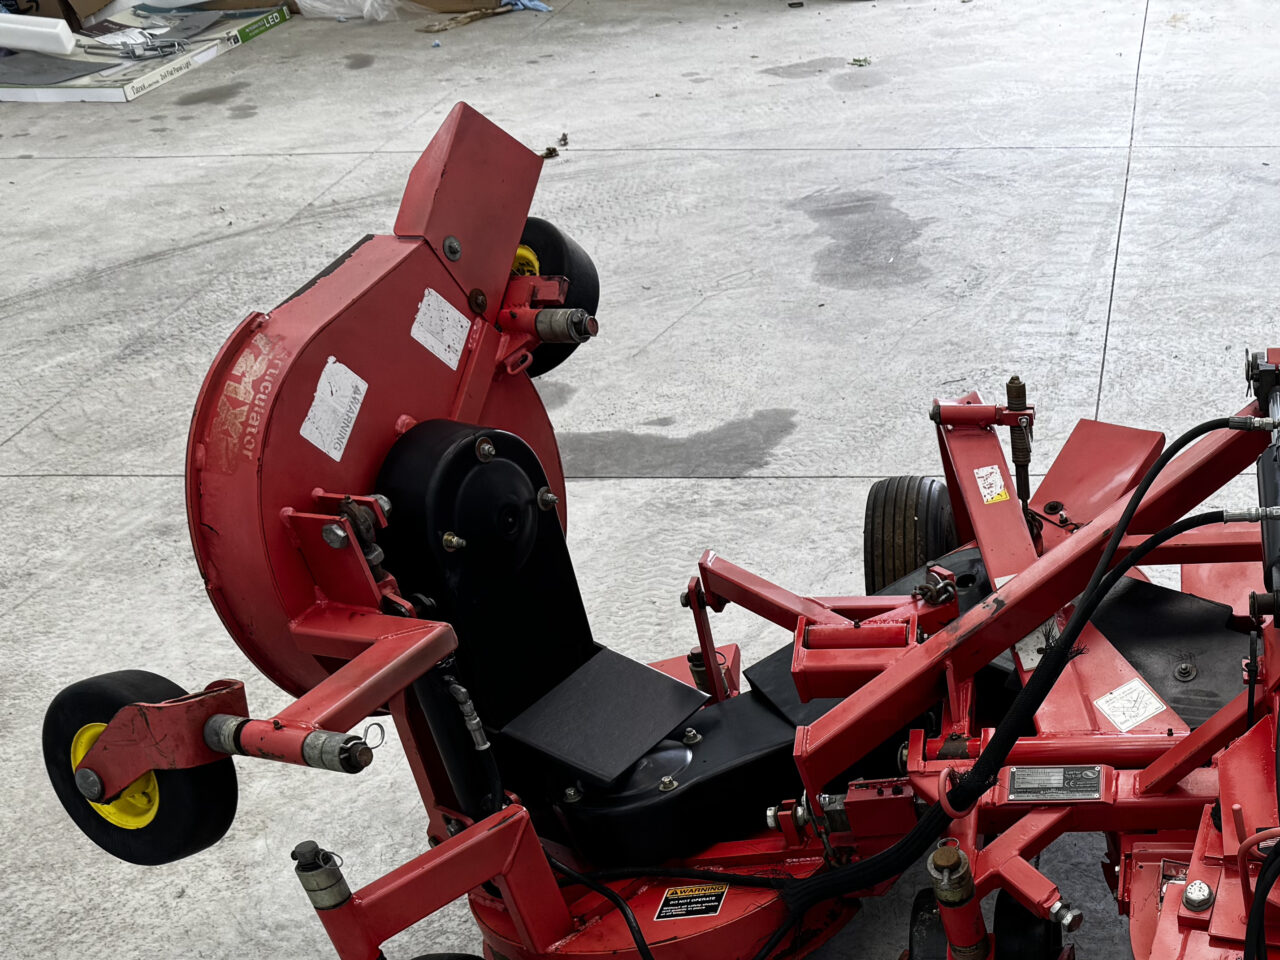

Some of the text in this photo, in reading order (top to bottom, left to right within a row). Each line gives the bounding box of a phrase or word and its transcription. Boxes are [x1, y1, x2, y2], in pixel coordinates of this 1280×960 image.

[263, 12, 280, 28] LED
[243, 340, 289, 459] rticulator
[333, 395, 361, 452] WARNING
[679, 885, 724, 895] WARNING
